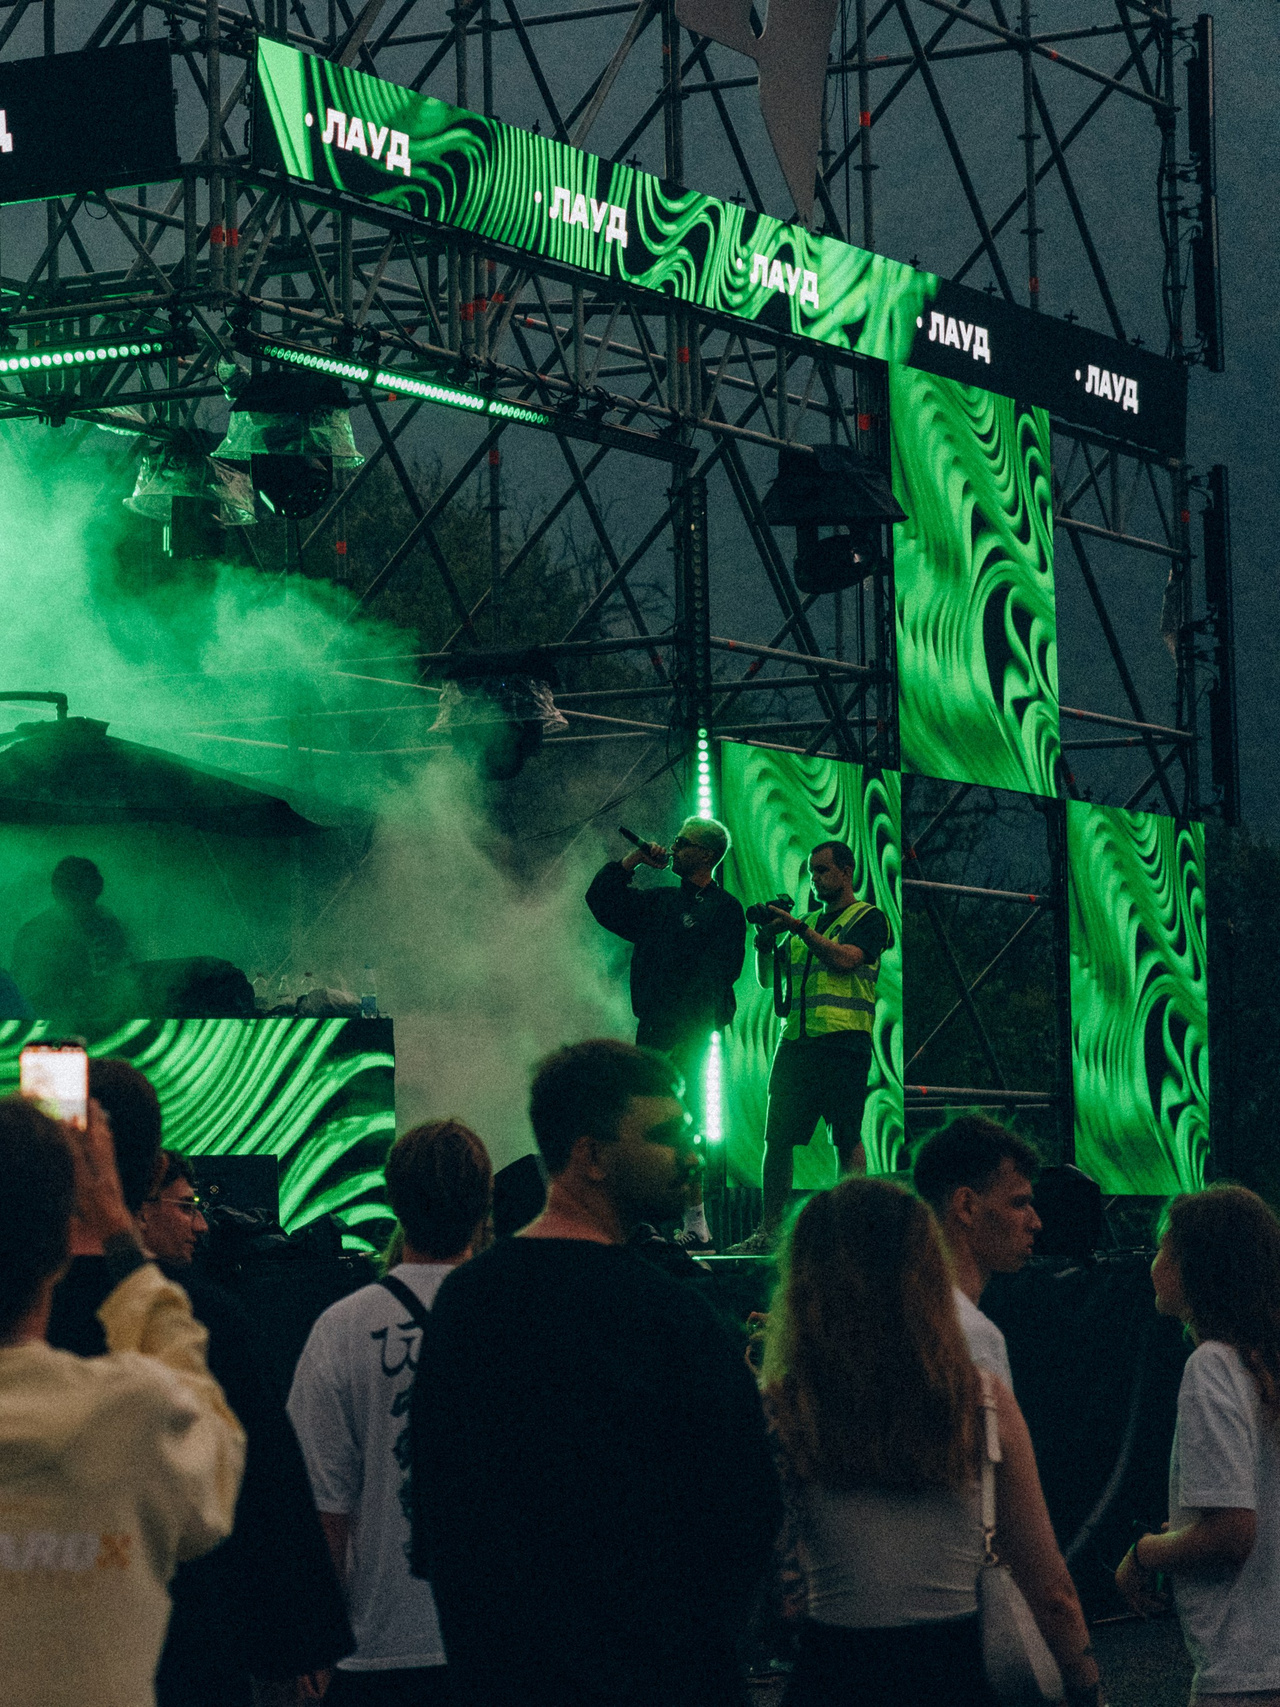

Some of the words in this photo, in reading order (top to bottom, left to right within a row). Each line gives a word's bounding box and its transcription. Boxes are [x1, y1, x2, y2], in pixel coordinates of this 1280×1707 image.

[322, 107, 411, 177] ЛАУД
[549, 185, 628, 249] ЛАУД
[749, 251, 820, 310] ЛАУД
[928, 311, 991, 364] ЛАУД
[1085, 364, 1139, 415] ЛАУД
